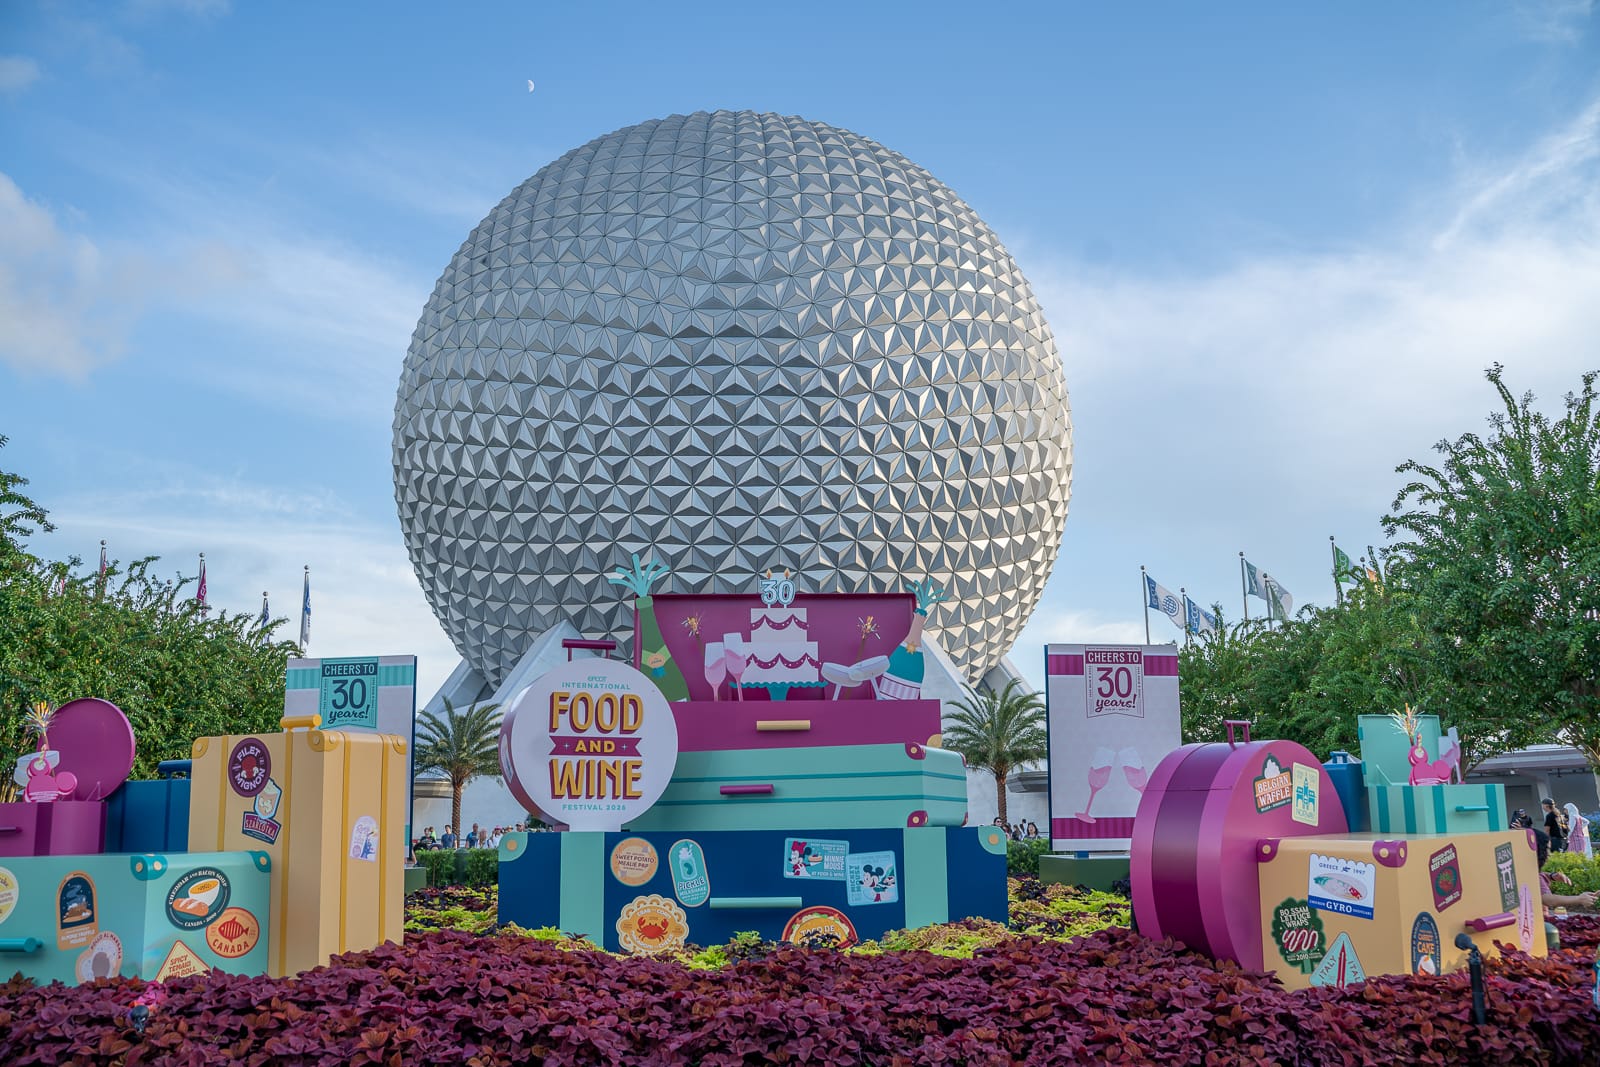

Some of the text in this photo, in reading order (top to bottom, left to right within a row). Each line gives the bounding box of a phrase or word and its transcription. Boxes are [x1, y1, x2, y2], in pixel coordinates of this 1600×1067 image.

[761, 580, 795, 603] 30
[1088, 652, 1139, 663] CHEERS TO
[324, 664, 375, 675] CHEERS TO
[561, 682, 631, 690] INTERNATIONAL
[1096, 666, 1132, 698] 30
[331, 678, 366, 710] 30
[1095, 694, 1137, 712] years!
[328, 704, 370, 724] years!
[549, 692, 644, 735] FOOD
[237, 746, 260, 761] FILET
[575, 740, 616, 753] AND
[235, 768, 265, 790] MIGNON
[549, 759, 643, 800] WINE
[1257, 774, 1289, 793] BELGIAN
[1258, 786, 1291, 807] WAFFLE
[616, 853, 633, 861] SWEET
[633, 855, 655, 863] POTATO
[1319, 862, 1339, 870] GREECE
[678, 876, 706, 890] PICKLE
[1290, 906, 1309, 914] SSAM
[1326, 901, 1353, 913] GYRO
[1280, 912, 1311, 922] LETTUCE
[1286, 919, 1309, 928] WRAPS
[824, 925, 835, 933] DE
[213, 939, 249, 953] CANADA
[170, 954, 188, 966] SPICY
[180, 966, 197, 976] ROLL
[1320, 956, 1337, 980] ITALY
[1348, 960, 1361, 982] ITAL
